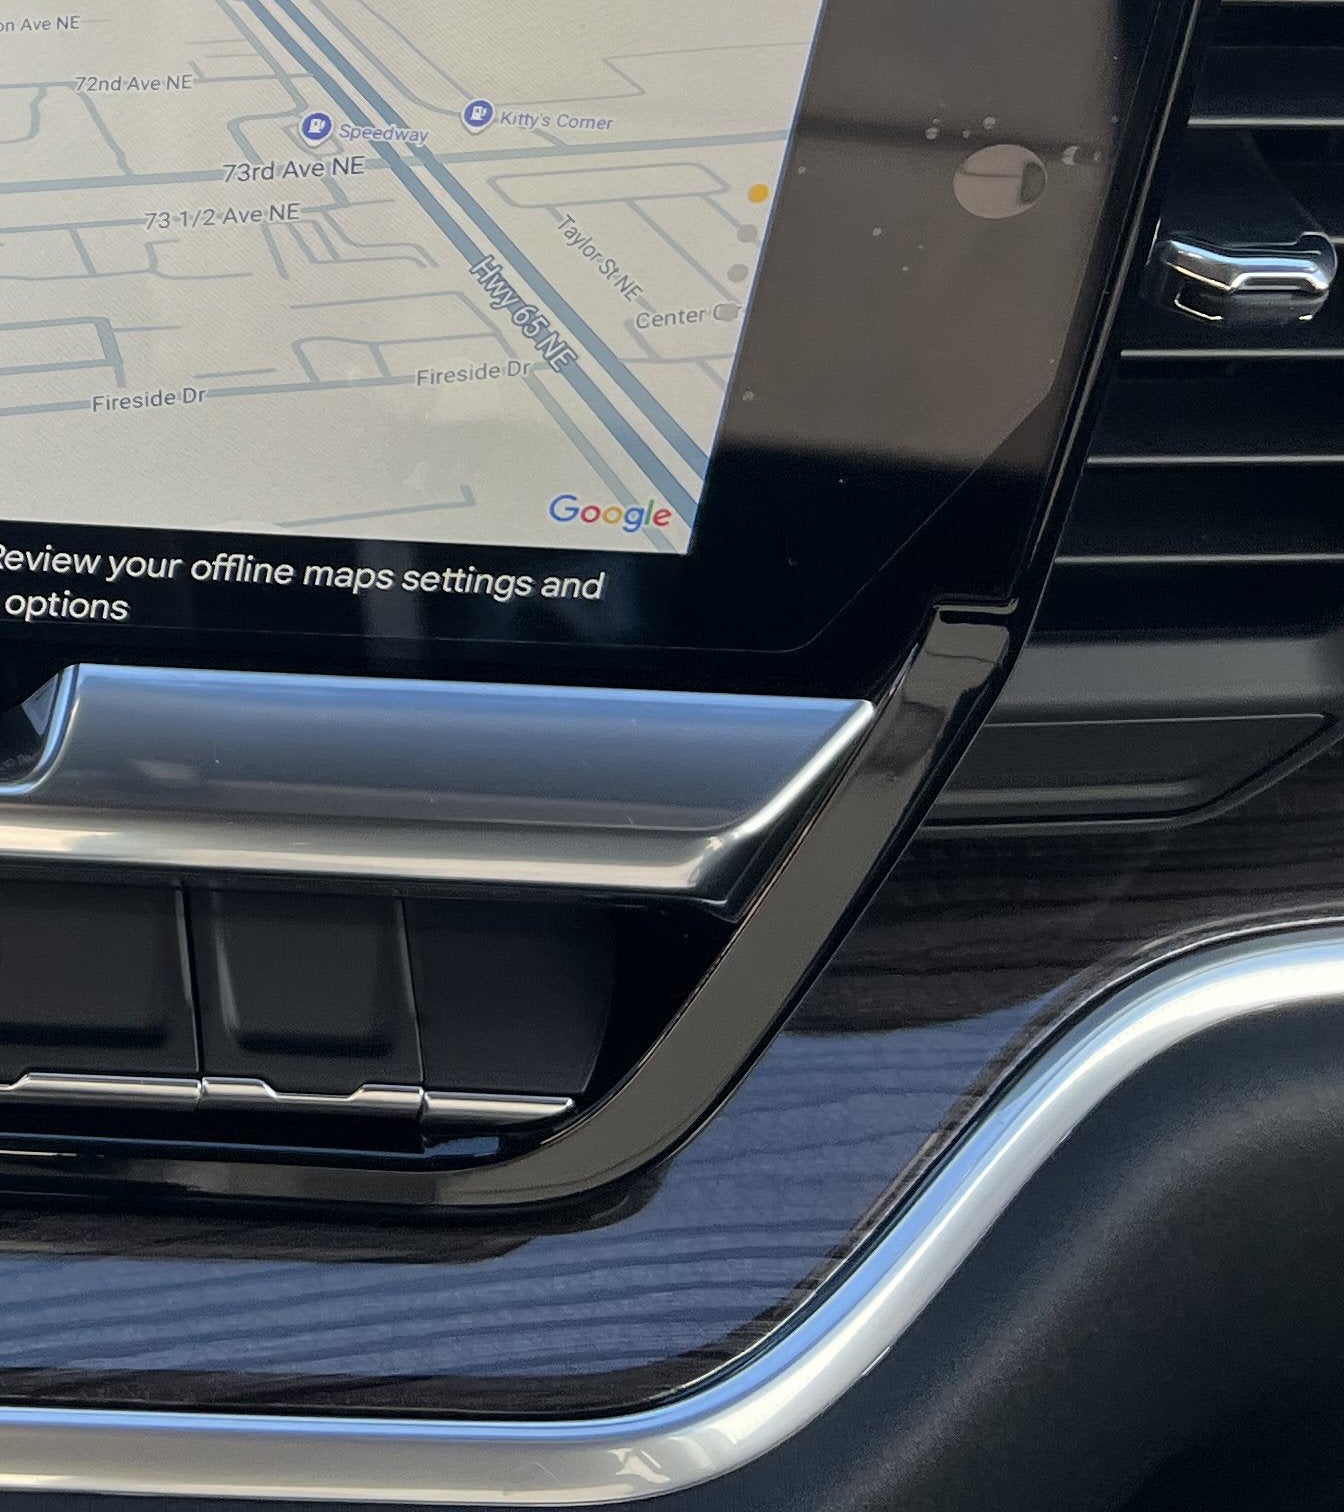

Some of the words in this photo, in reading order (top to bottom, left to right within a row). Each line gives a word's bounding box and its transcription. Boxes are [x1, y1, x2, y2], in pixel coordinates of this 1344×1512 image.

[20, 18, 52, 31] Ave
[56, 15, 80, 30] NE
[75, 75, 122, 92] 72nd
[127, 76, 161, 91] Ave
[166, 74, 193, 90] NE
[339, 123, 429, 145] Speedway
[500, 111, 551, 128] Kitty's
[556, 113, 614, 131] Corner
[223, 160, 275, 183] 73rd
[281, 160, 324, 179] Ave
[332, 155, 365, 176] NE
[146, 212, 170, 229] 73
[179, 208, 216, 227] 1/2
[222, 208, 263, 224] Ave
[269, 203, 301, 220] NE
[557, 214, 603, 262] Taylor
[598, 258, 619, 280] St
[614, 274, 643, 302] NE
[469, 254, 520, 310] Hwy
[512, 304, 551, 339] 65
[534, 331, 579, 373] NE
[636, 308, 705, 329] Center
[416, 363, 501, 386] Fireside
[507, 360, 531, 378] Dr
[92, 389, 176, 412] Fireside
[182, 386, 207, 405] Dr
[548, 493, 673, 533] Google
[108, 555, 183, 582] your
[191, 552, 294, 585] offline
[303, 566, 393, 595] maps
[402, 566, 533, 603] settings
[541, 571, 606, 600] and
[5, 591, 130, 624] options
